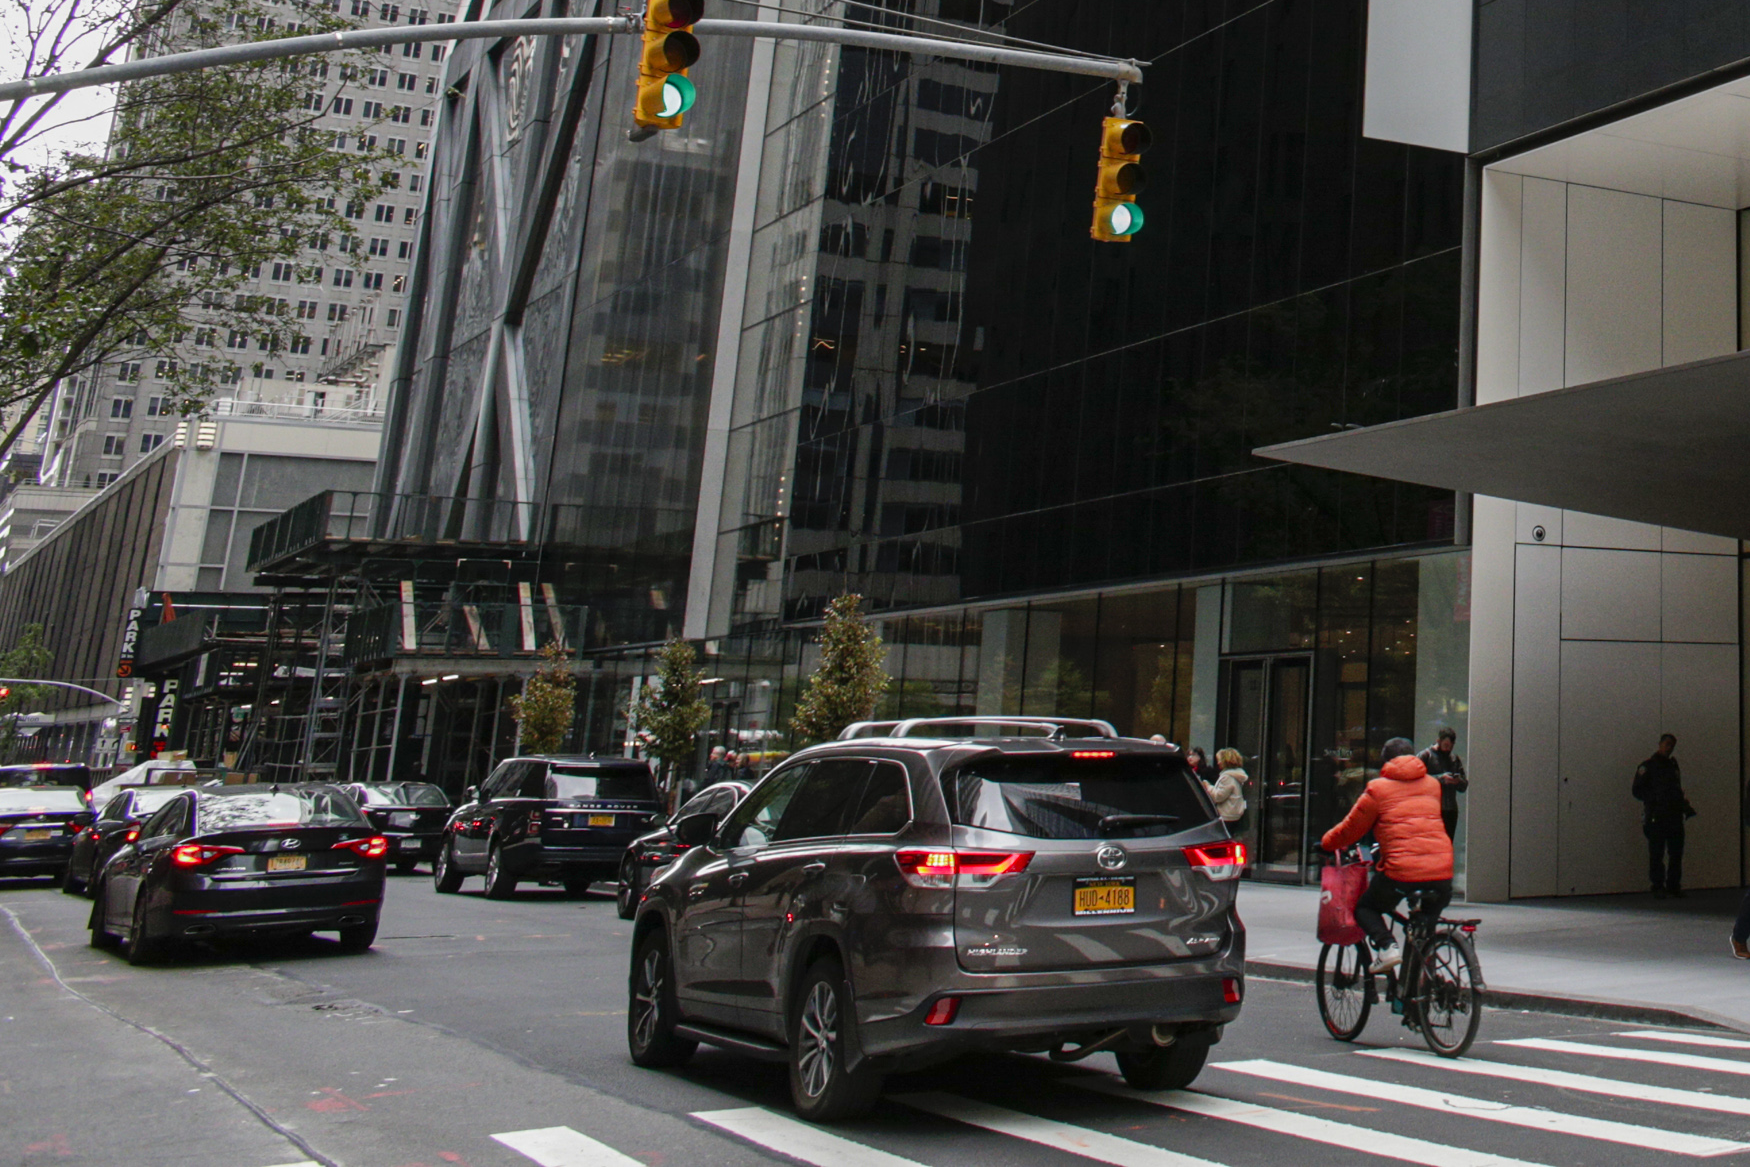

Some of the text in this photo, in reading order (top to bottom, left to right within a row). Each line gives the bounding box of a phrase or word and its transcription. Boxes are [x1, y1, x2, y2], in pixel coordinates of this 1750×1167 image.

[122, 609, 142, 654] PARK
[153, 679, 179, 738] PARK
[967, 948, 1028, 956] HIGHLANDER
